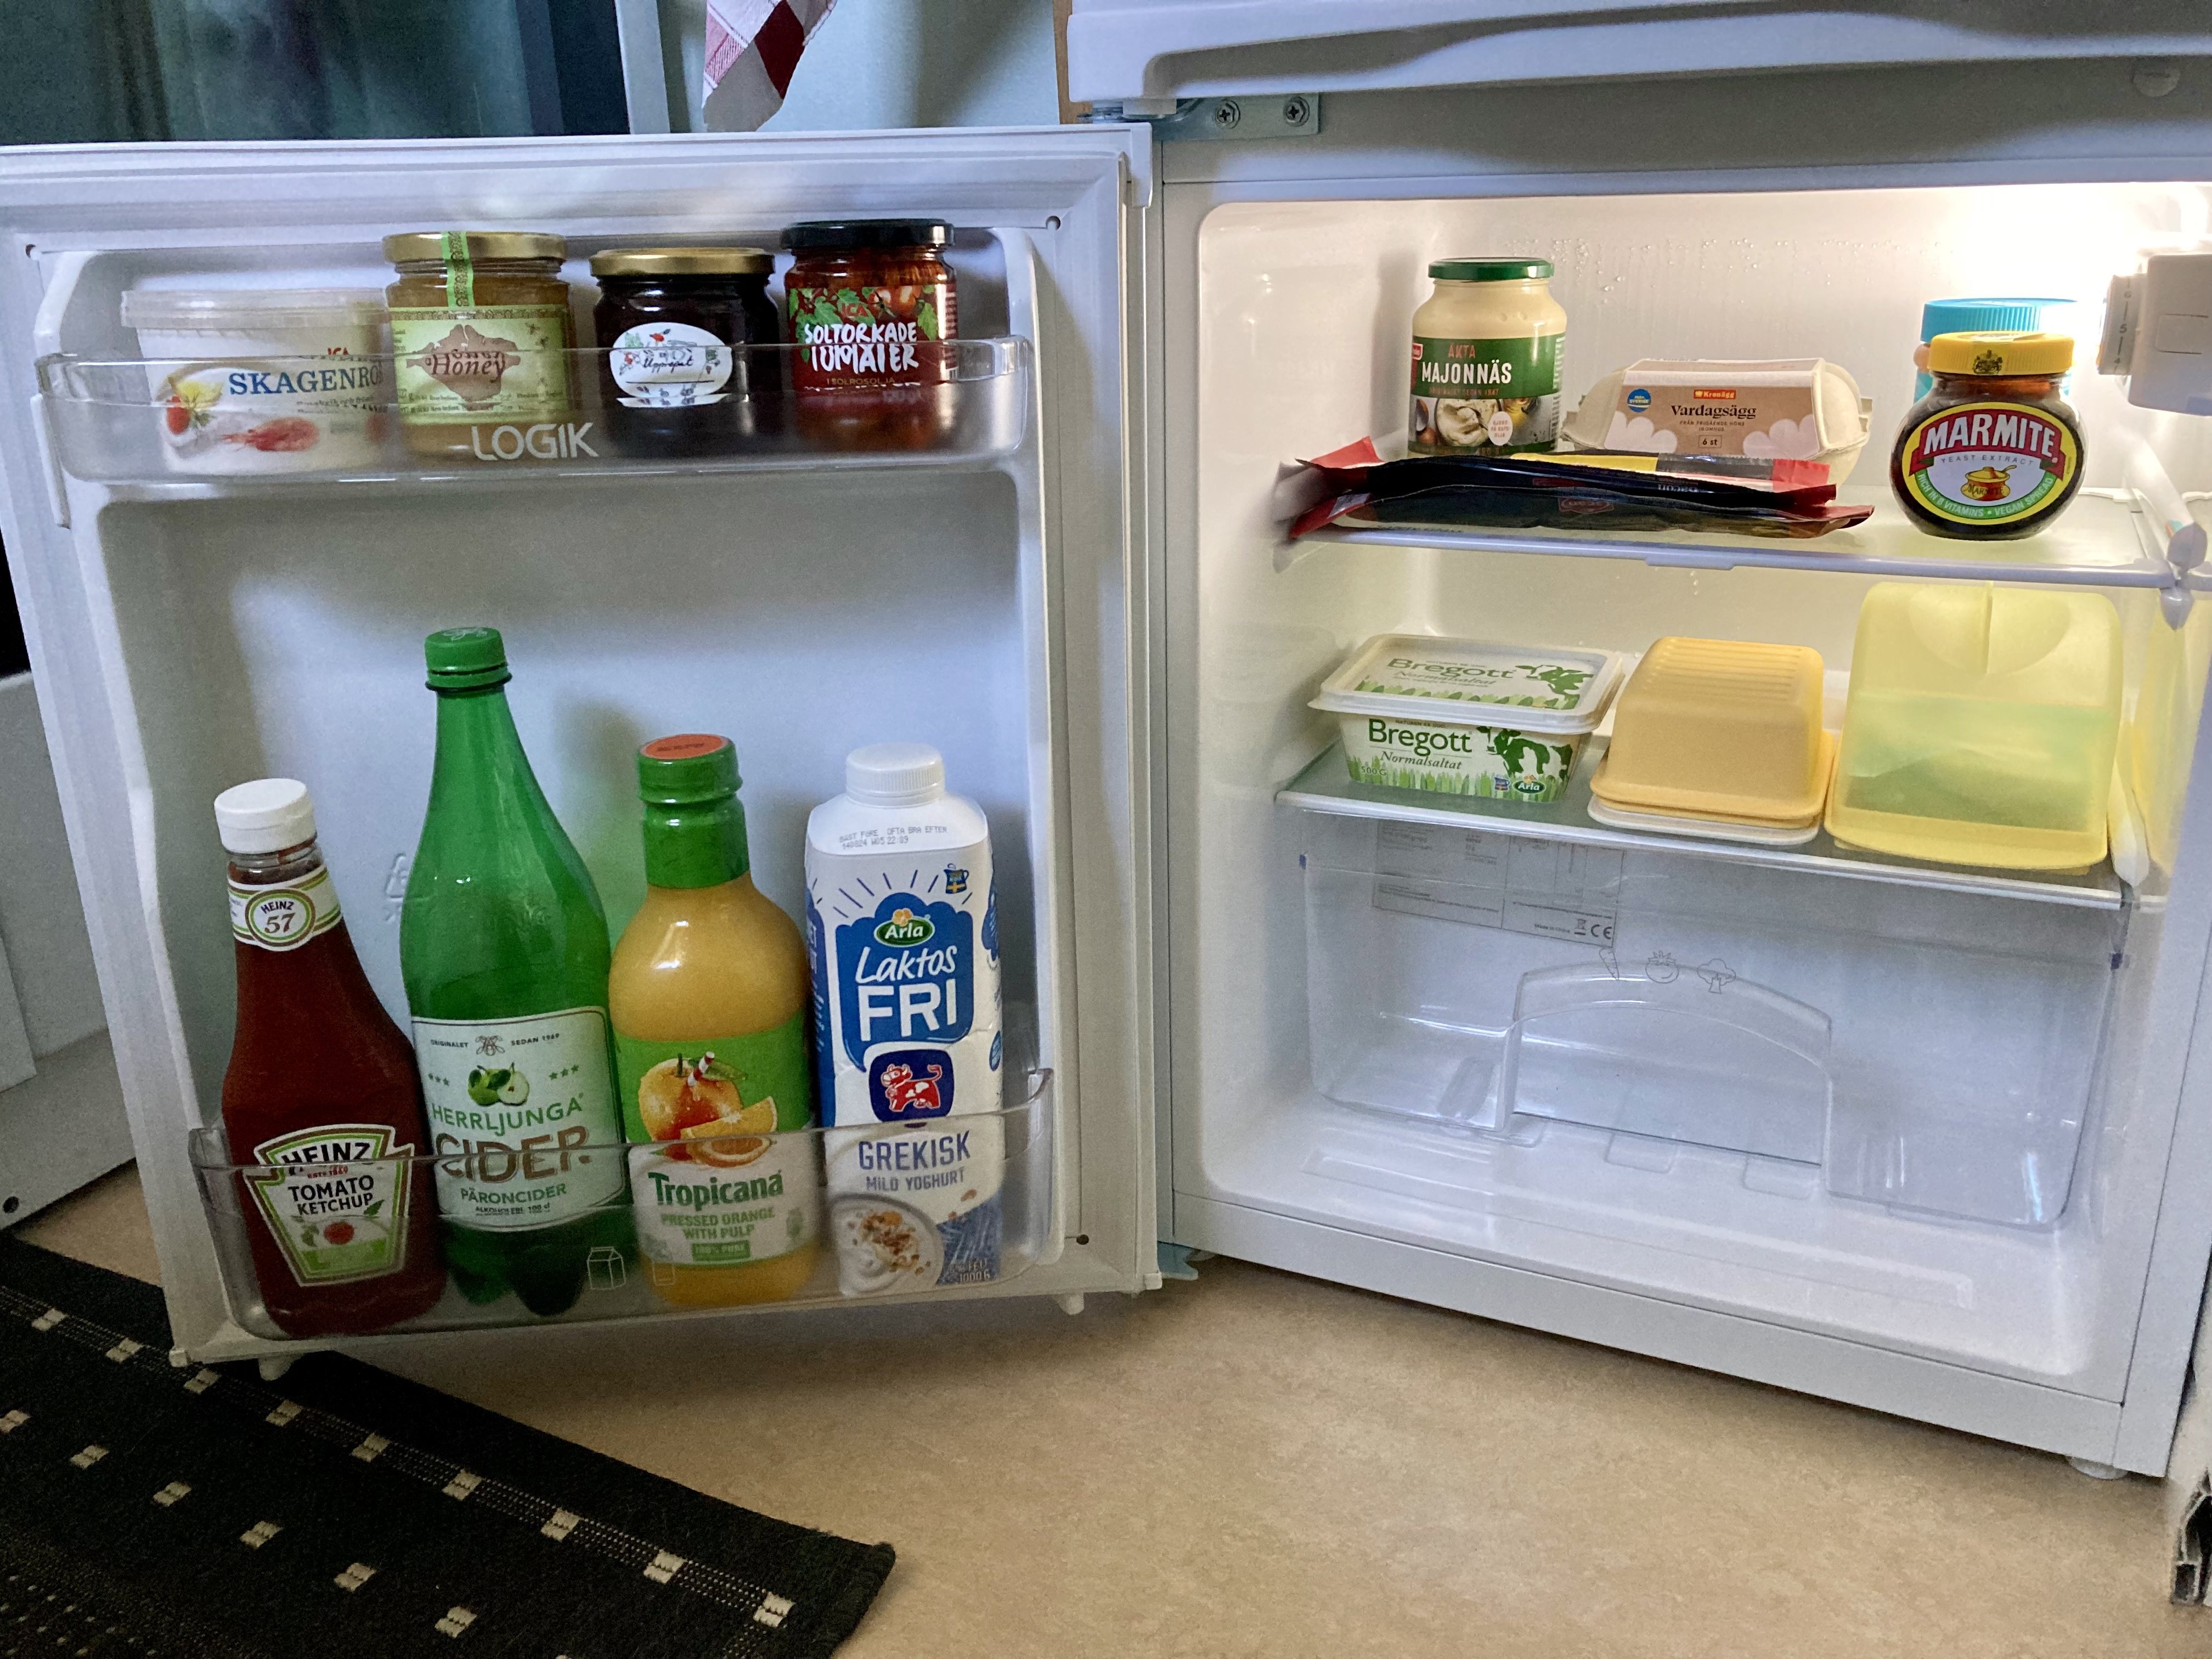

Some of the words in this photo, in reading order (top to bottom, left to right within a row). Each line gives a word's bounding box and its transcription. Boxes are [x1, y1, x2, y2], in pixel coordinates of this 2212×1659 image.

[841, 303, 868, 317] ICA
[804, 321, 917, 344] SOLTORKADE
[1448, 343, 1476, 359] ÄKTA
[432, 353, 505, 383] Honey
[1421, 359, 1512, 385] MAJONNÄS
[1703, 390, 1735, 399] Kronägg
[1671, 404, 1757, 420] Vardagsägg
[471, 422, 600, 461] LOGIK
[1923, 413, 2055, 458] MARMITE
[1940, 454, 1976, 464] YEAST
[1982, 454, 2034, 466] EXTRACT
[1917, 473, 1931, 493] RICH
[1928, 490, 1939, 500] IN
[1944, 499, 1984, 517] VITAMINS
[1994, 502, 2024, 516] VEGAN
[2027, 477, 2053, 505] SPREAD
[1386, 658, 1513, 678] Bregott
[1369, 718, 1472, 757] Bregott
[1361, 766, 1376, 776] 500
[1380, 751, 1463, 770] Normalsaltat
[1518, 782, 1540, 791] Arla
[887, 827, 905, 836] OFTA
[925, 826, 948, 834] EFTER
[261, 900, 295, 914] HEINZ
[264, 912, 296, 933] 57
[884, 922, 923, 940] Arla
[855, 945, 958, 984] Laktos
[857, 979, 957, 1042] FRI
[430, 1039, 469, 1048] ORIGINALET
[511, 1036, 539, 1047] SEDAN
[541, 1032, 560, 1041] 1969
[431, 1096, 583, 1137] HERRLJUNGA
[859, 1130, 971, 1171] GREKISK
[287, 1175, 374, 1202] TOMATO
[866, 1175, 899, 1192] MILD
[904, 1166, 966, 1192] YOGHURT
[460, 1182, 567, 1204] PÄRONCIDER
[648, 1171, 784, 1211] Tropicana
[297, 1192, 373, 1216] KETCHUP
[661, 1213, 719, 1227] PRESSED
[721, 1206, 776, 1226] ORANGE
[681, 1227, 718, 1240] WITH
[720, 1223, 755, 1239] PULP
